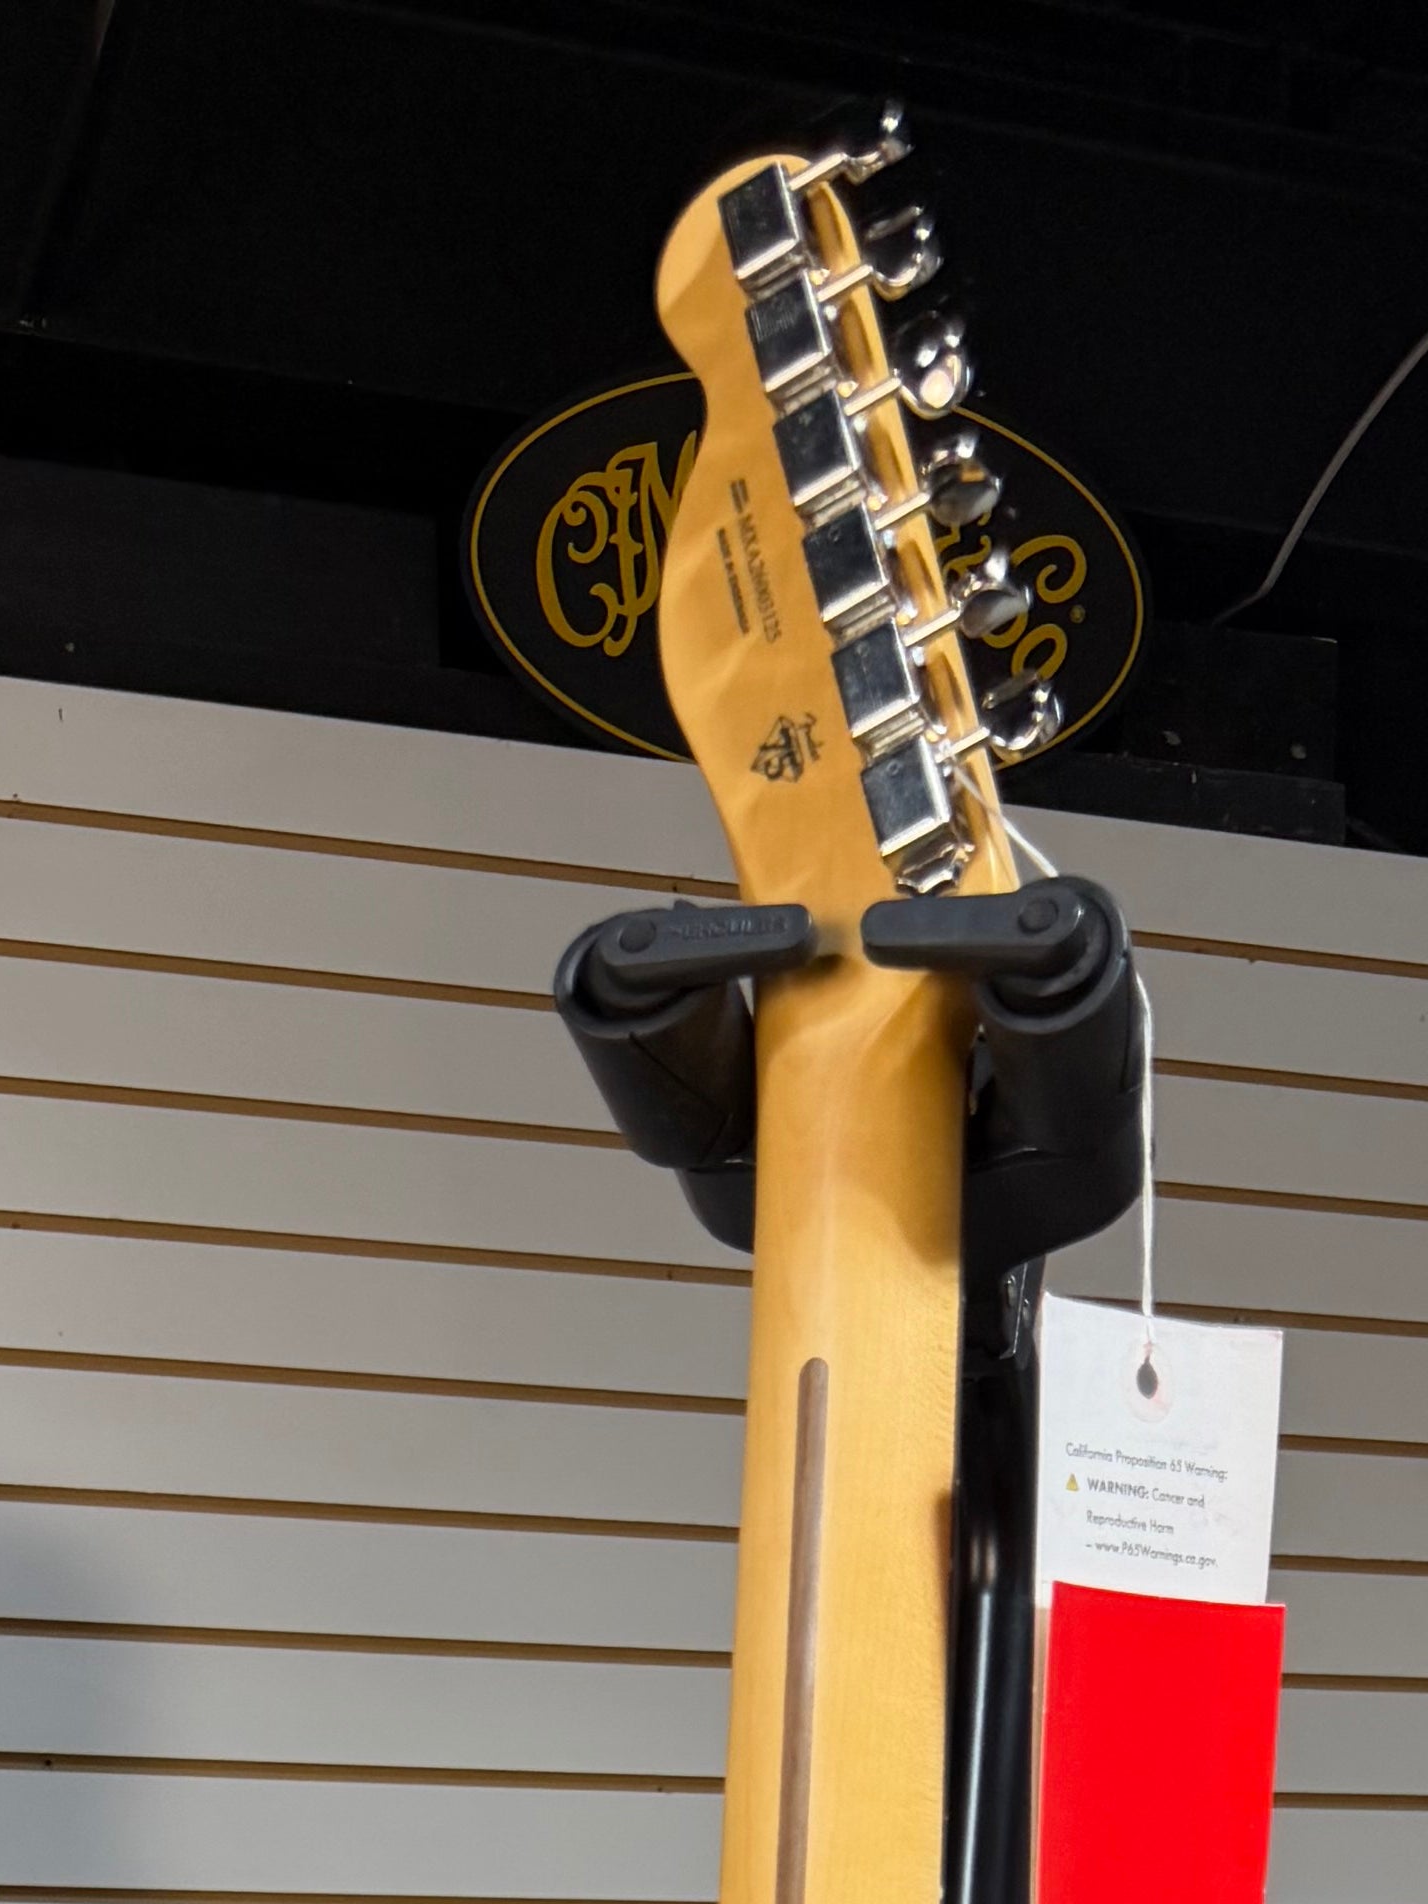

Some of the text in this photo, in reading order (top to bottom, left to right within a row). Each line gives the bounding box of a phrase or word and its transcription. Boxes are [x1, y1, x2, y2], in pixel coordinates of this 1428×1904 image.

[1066, 1442, 1228, 1482] California Proposition 65 Warning:
[1087, 1477, 1205, 1508] WARNING: Cancer and
[1086, 1510, 1174, 1535] Reproductive Harm
